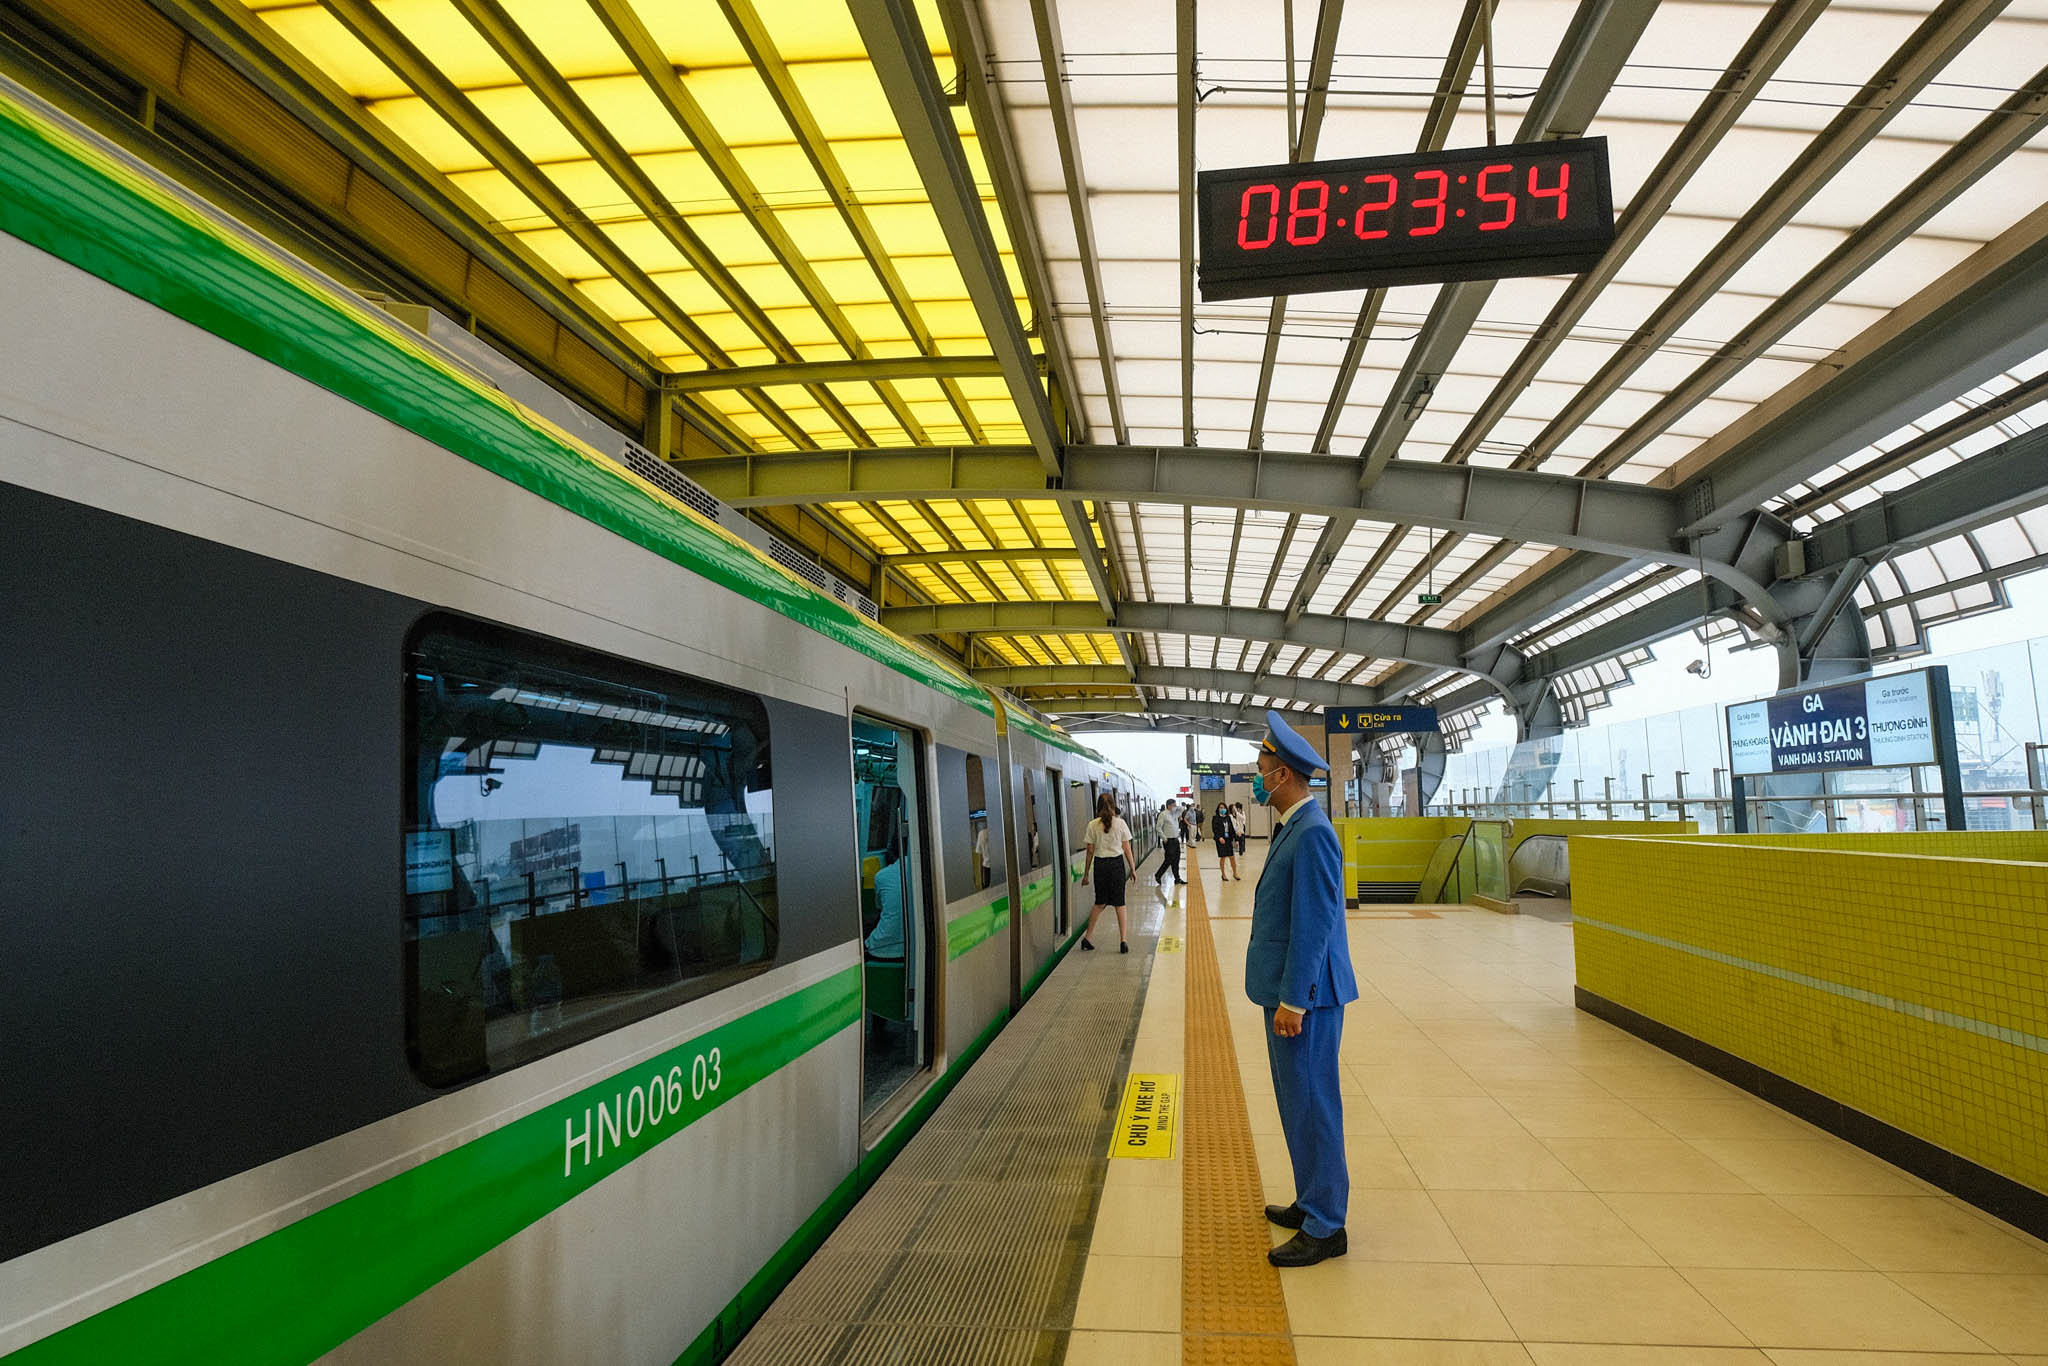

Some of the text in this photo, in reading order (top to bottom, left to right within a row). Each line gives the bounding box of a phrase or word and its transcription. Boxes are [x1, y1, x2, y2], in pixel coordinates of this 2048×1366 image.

[1237, 162, 1571, 250] 08:23:54
[1802, 693, 1824, 714] GA
[1771, 716, 1867, 749] VÀNH ĐAI 3
[1777, 752, 1801, 767] VANH
[1801, 751, 1816, 765] DAI
[1817, 751, 1823, 764] 3
[1823, 748, 1863, 763] STATION
[564, 1047, 721, 1178] HN006 03
[1135, 1094, 1154, 1112] KHE
[1127, 1123, 1149, 1146] CHÚ
